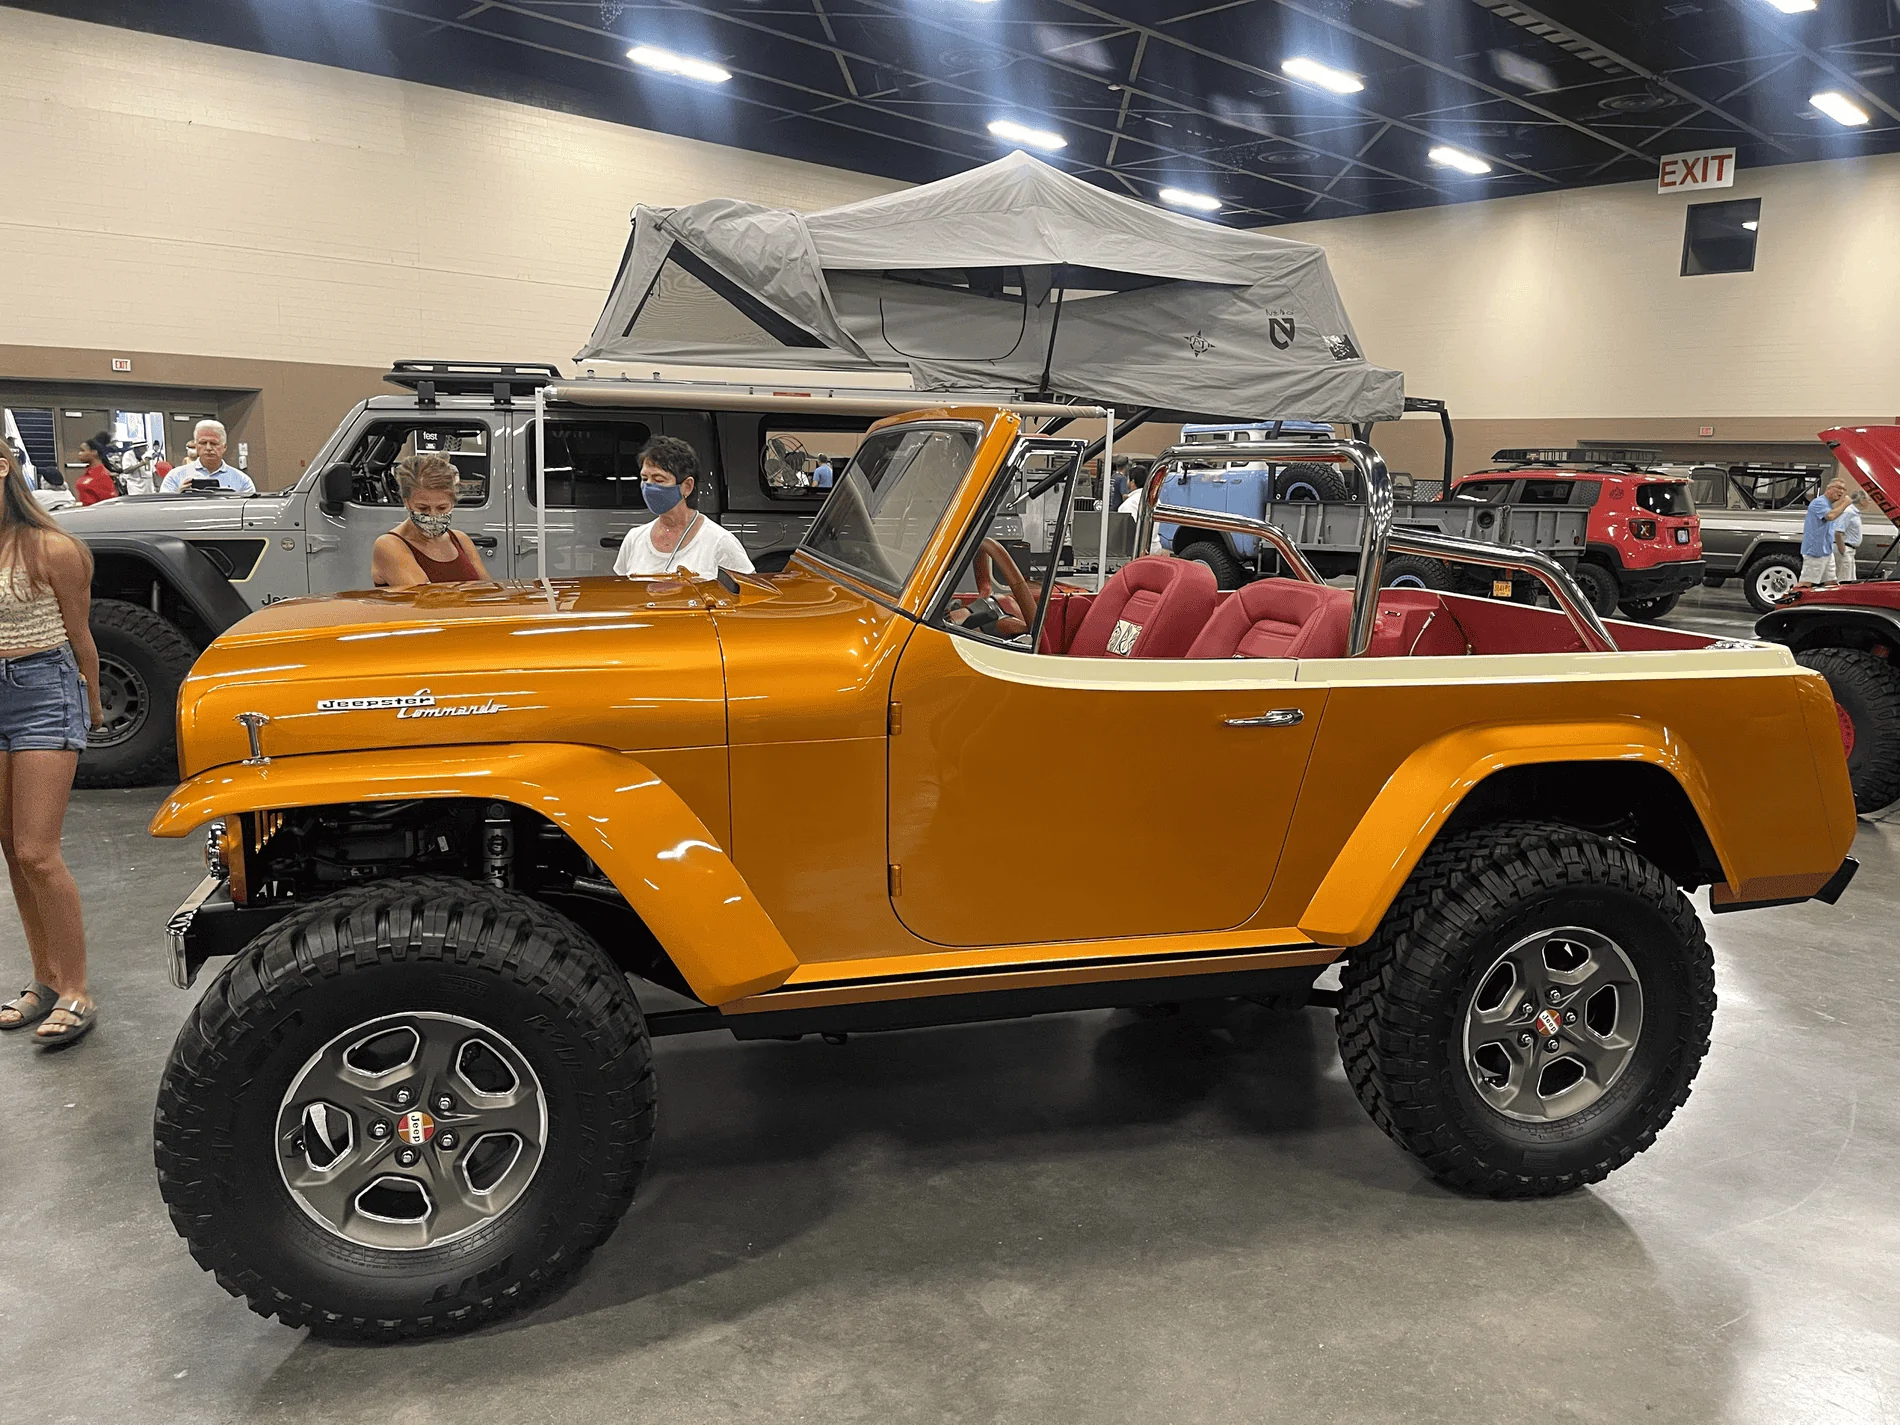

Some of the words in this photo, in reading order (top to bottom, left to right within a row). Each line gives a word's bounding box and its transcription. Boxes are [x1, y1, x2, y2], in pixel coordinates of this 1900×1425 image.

[1659, 153, 1733, 188] EXIT
[422, 431, 438, 441] fest
[321, 696, 433, 710] Jeepster
[397, 688, 508, 719] Commando
[1541, 1014, 1557, 1032] Jeep
[411, 1115, 421, 1142] Jeep
